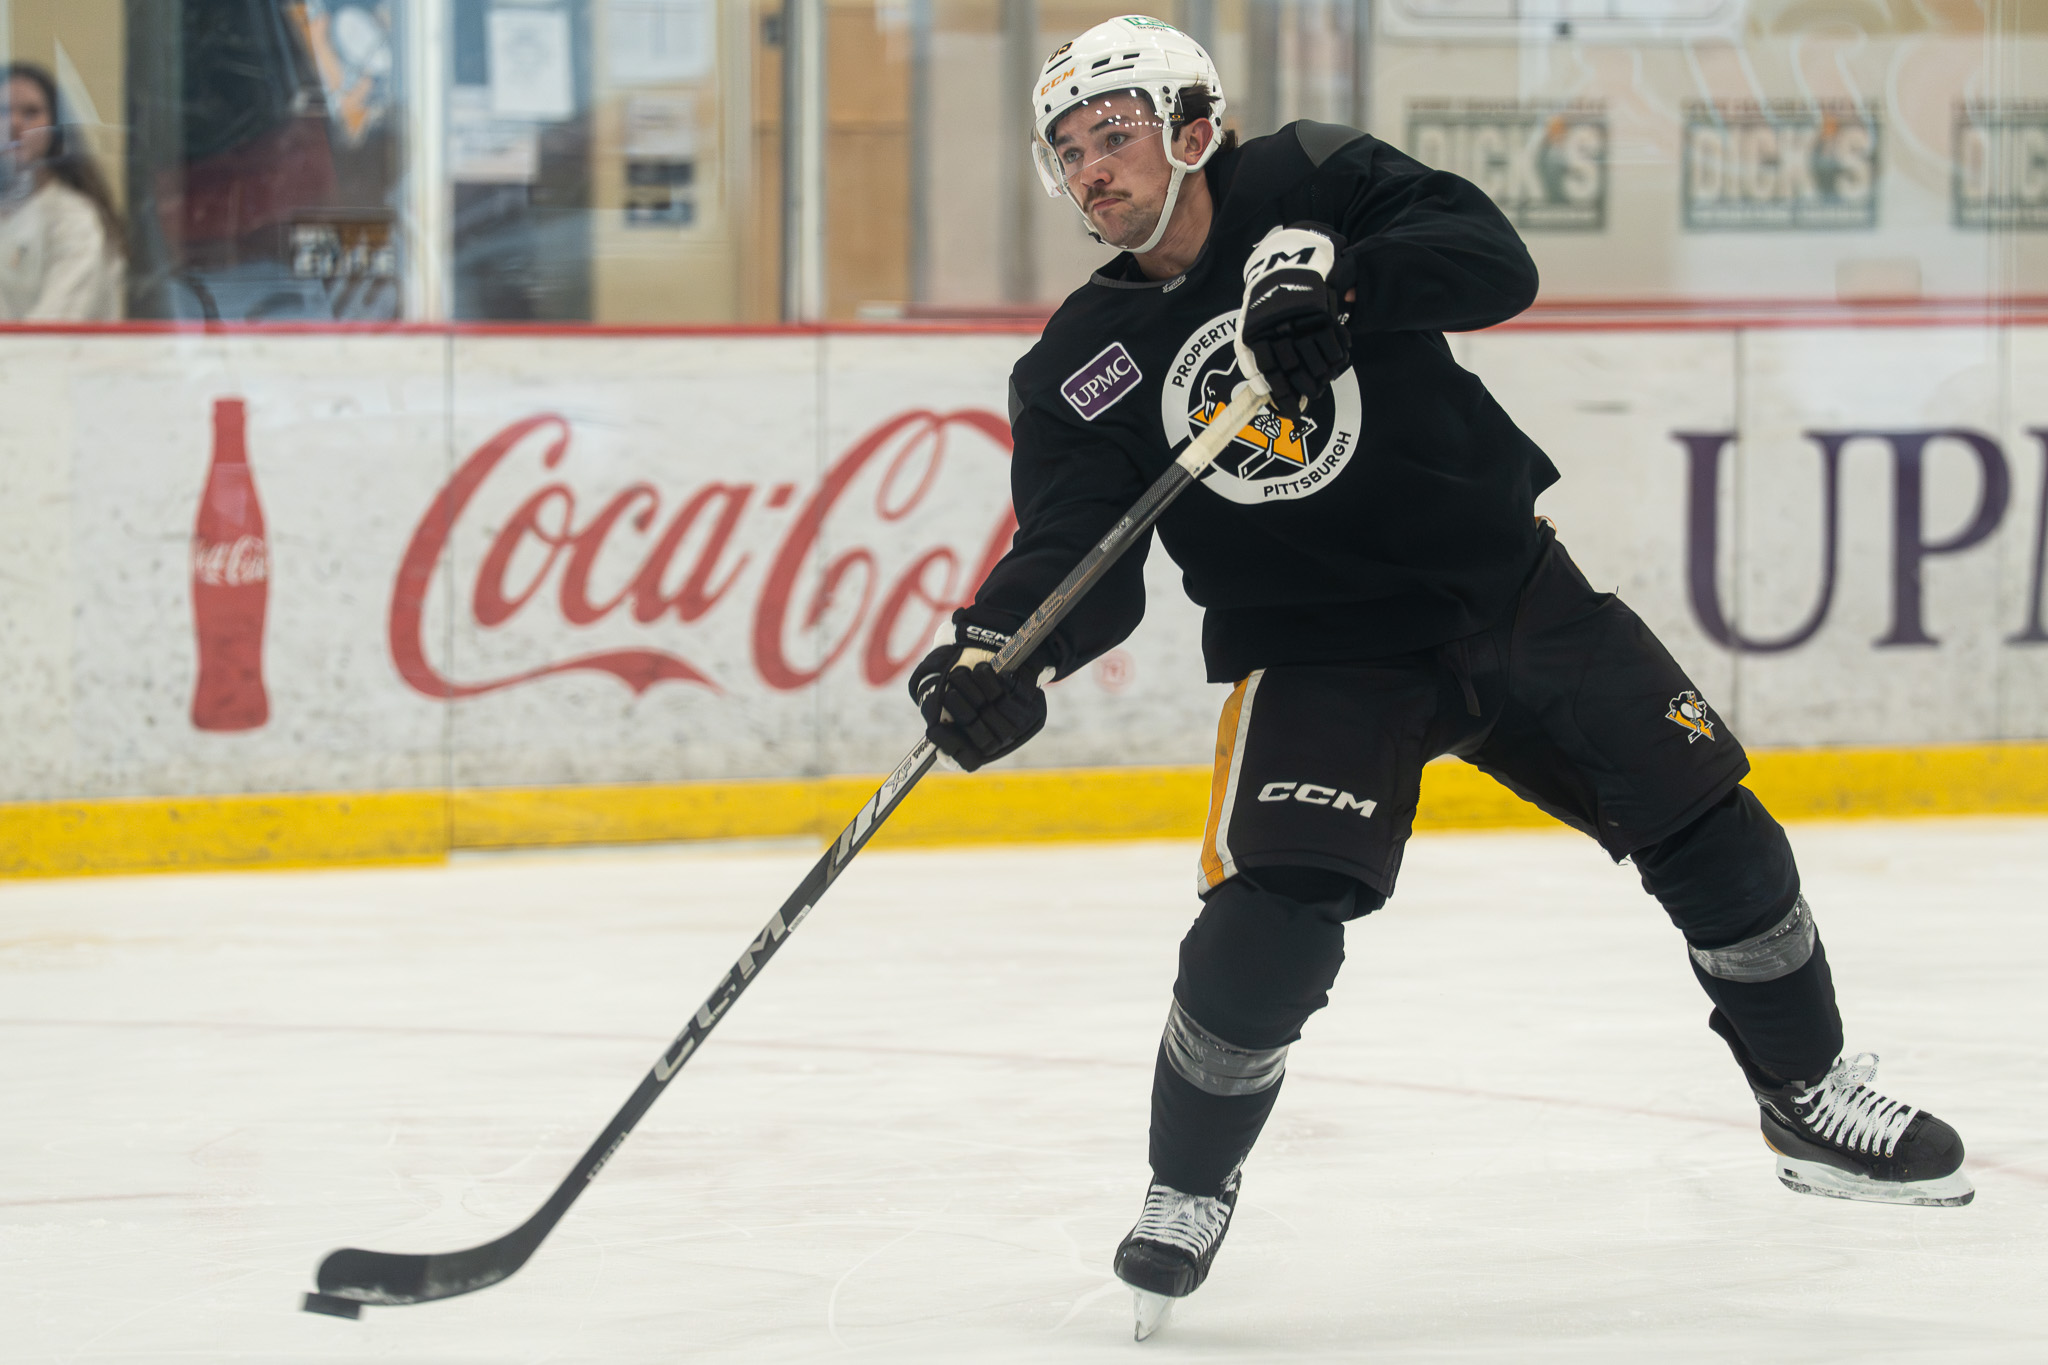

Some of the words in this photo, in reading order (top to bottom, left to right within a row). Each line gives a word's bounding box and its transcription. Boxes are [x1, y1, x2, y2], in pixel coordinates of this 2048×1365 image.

[1041, 67, 1075, 96] CCM
[1070, 356, 1132, 408] UPMC
[1172, 317, 1240, 388] PROPERTY
[1263, 431, 1352, 497] PITTSBURGH
[1669, 428, 2048, 653] UP
[966, 625, 1011, 642] CCM
[1257, 782, 1377, 818] CCM
[655, 910, 786, 1082] CCM
